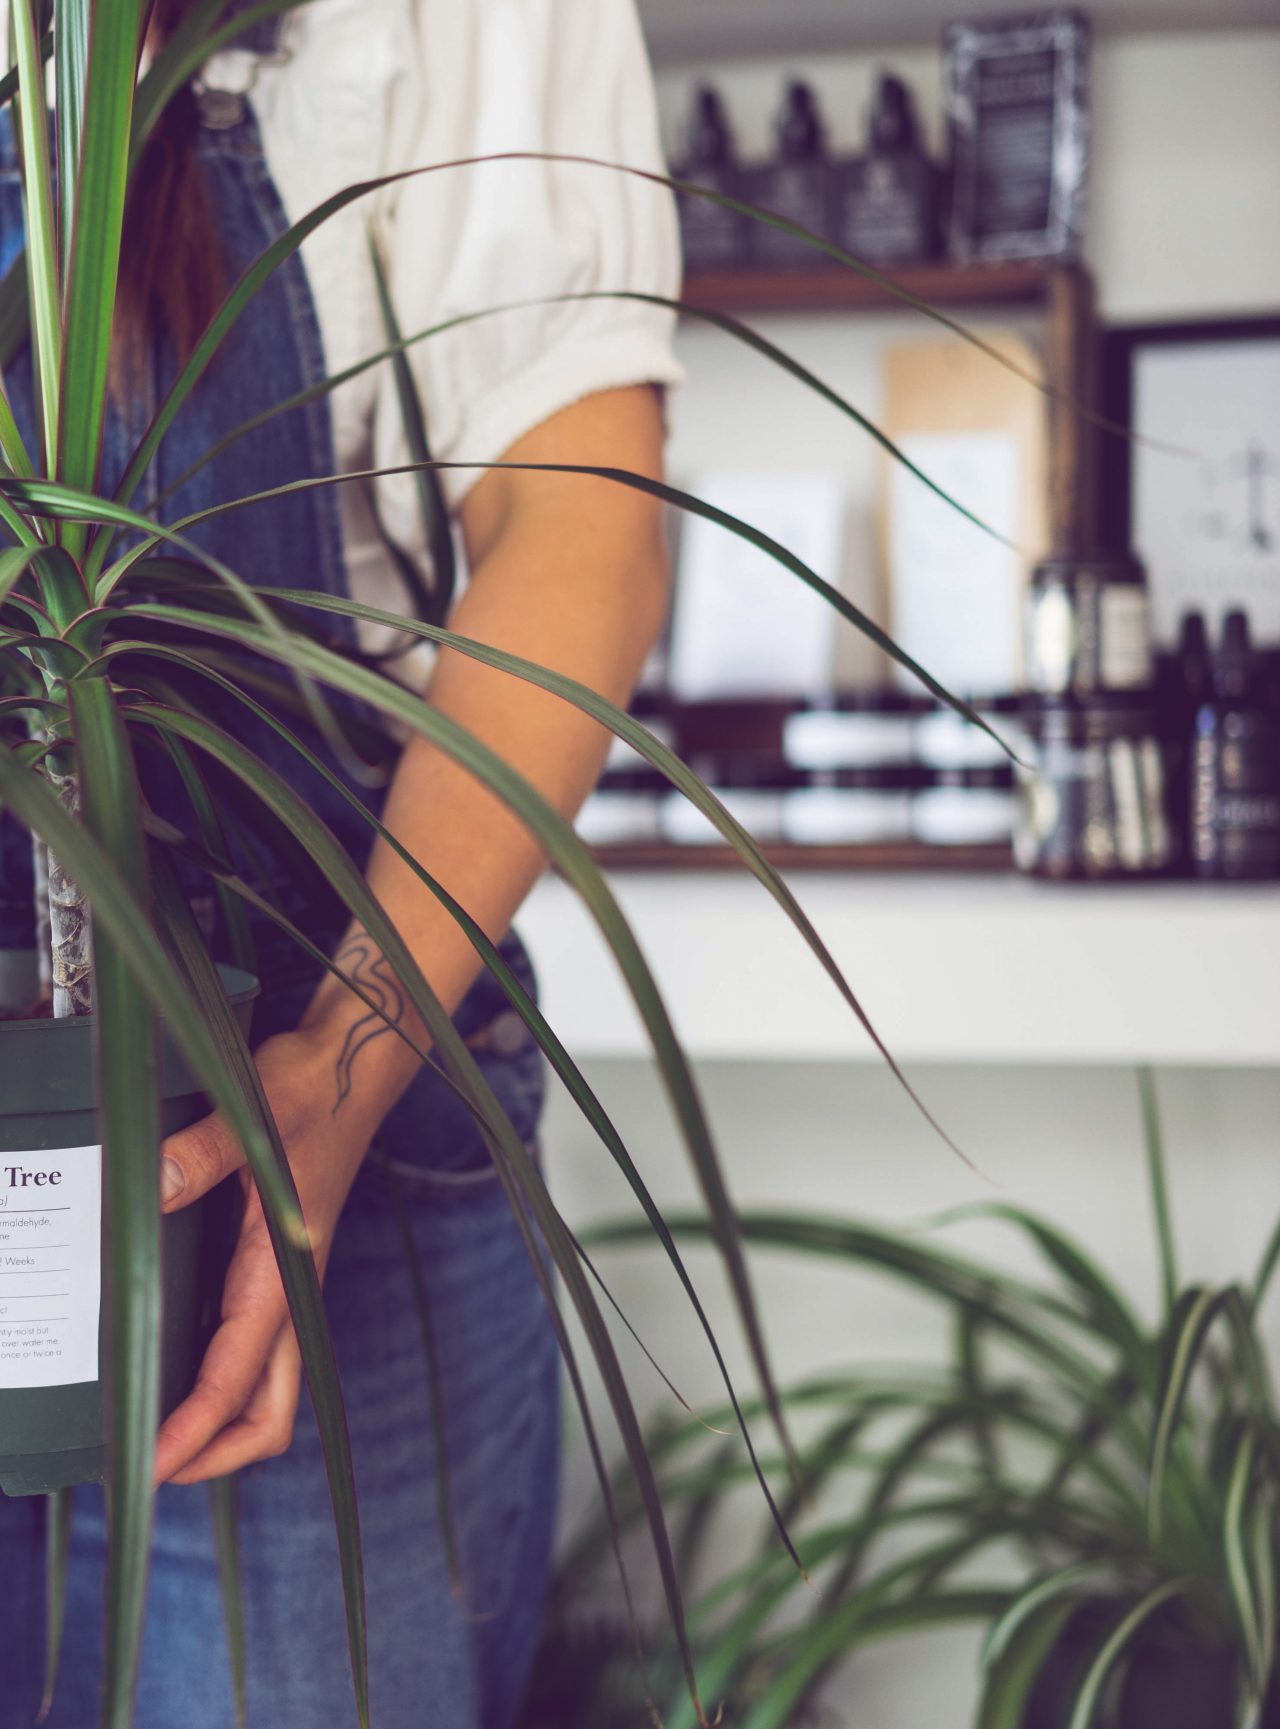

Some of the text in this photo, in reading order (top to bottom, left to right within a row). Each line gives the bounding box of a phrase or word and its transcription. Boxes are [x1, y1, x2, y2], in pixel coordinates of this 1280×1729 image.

[4, 1166, 62, 1187] Tree
[4, 1256, 36, 1266] Weeks
[14, 1327, 35, 1336] moist
[36, 1326, 49, 1335] but
[22, 1339, 44, 1347] water
[0, 1351, 21, 1359] once
[33, 1349, 54, 1357] twice
